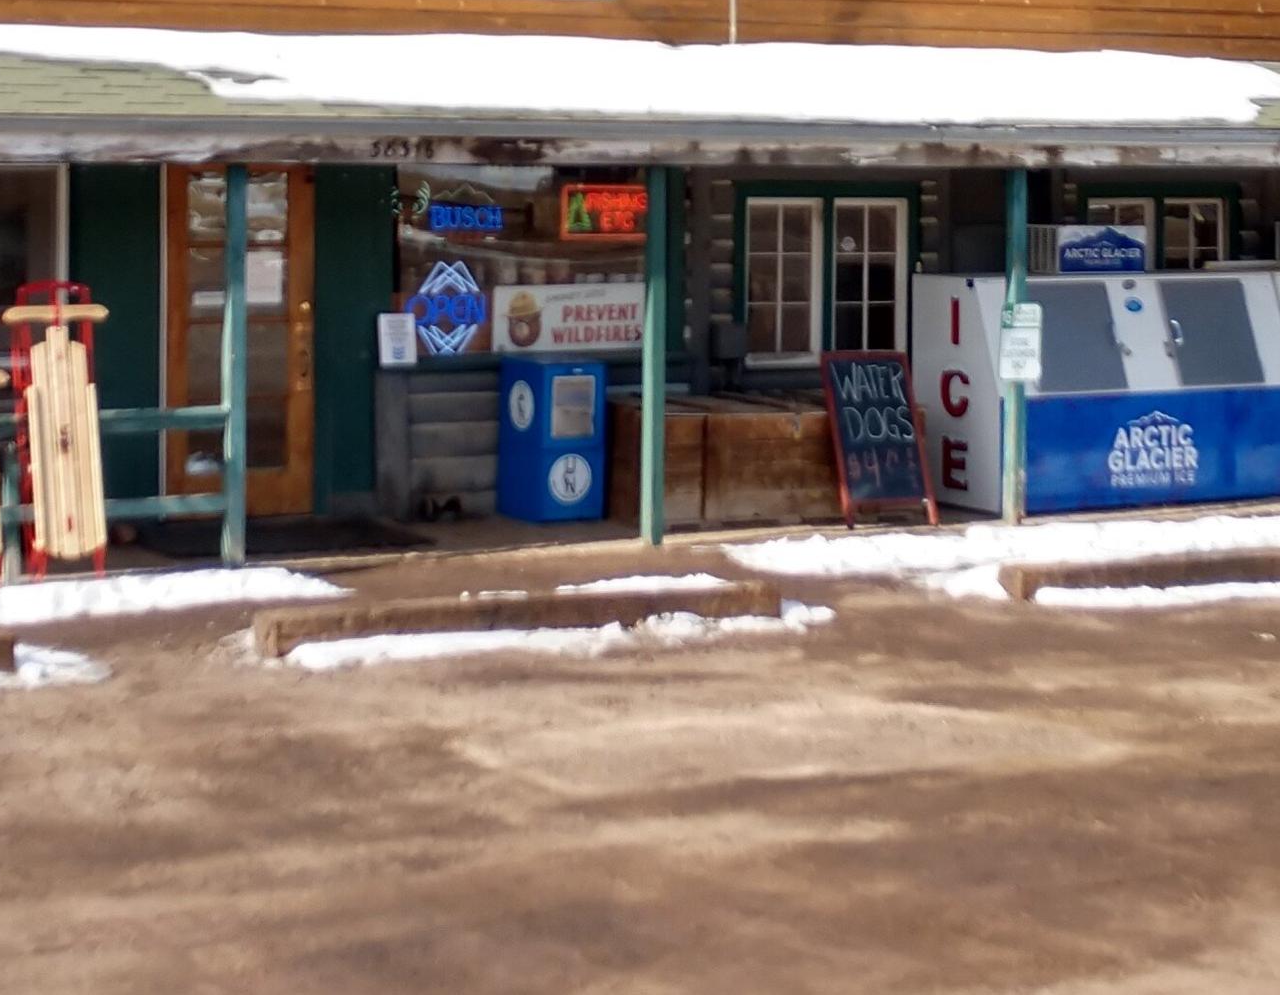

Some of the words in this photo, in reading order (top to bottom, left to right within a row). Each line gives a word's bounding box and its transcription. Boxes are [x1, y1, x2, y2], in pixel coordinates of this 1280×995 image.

[430, 205, 504, 229] BUSCH
[404, 293, 485, 326] OPEN
[561, 303, 638, 323] PREVENT
[551, 323, 642, 345] WILDFIRES
[829, 361, 908, 405] WATER
[940, 294, 970, 492] ICE
[841, 405, 916, 441] DOGS
[1114, 423, 1194, 449] ARCTIC
[1107, 445, 1199, 475] GLACIER
[1110, 470, 1173, 488] PREMIUM
[1174, 468, 1196, 485] ICE
